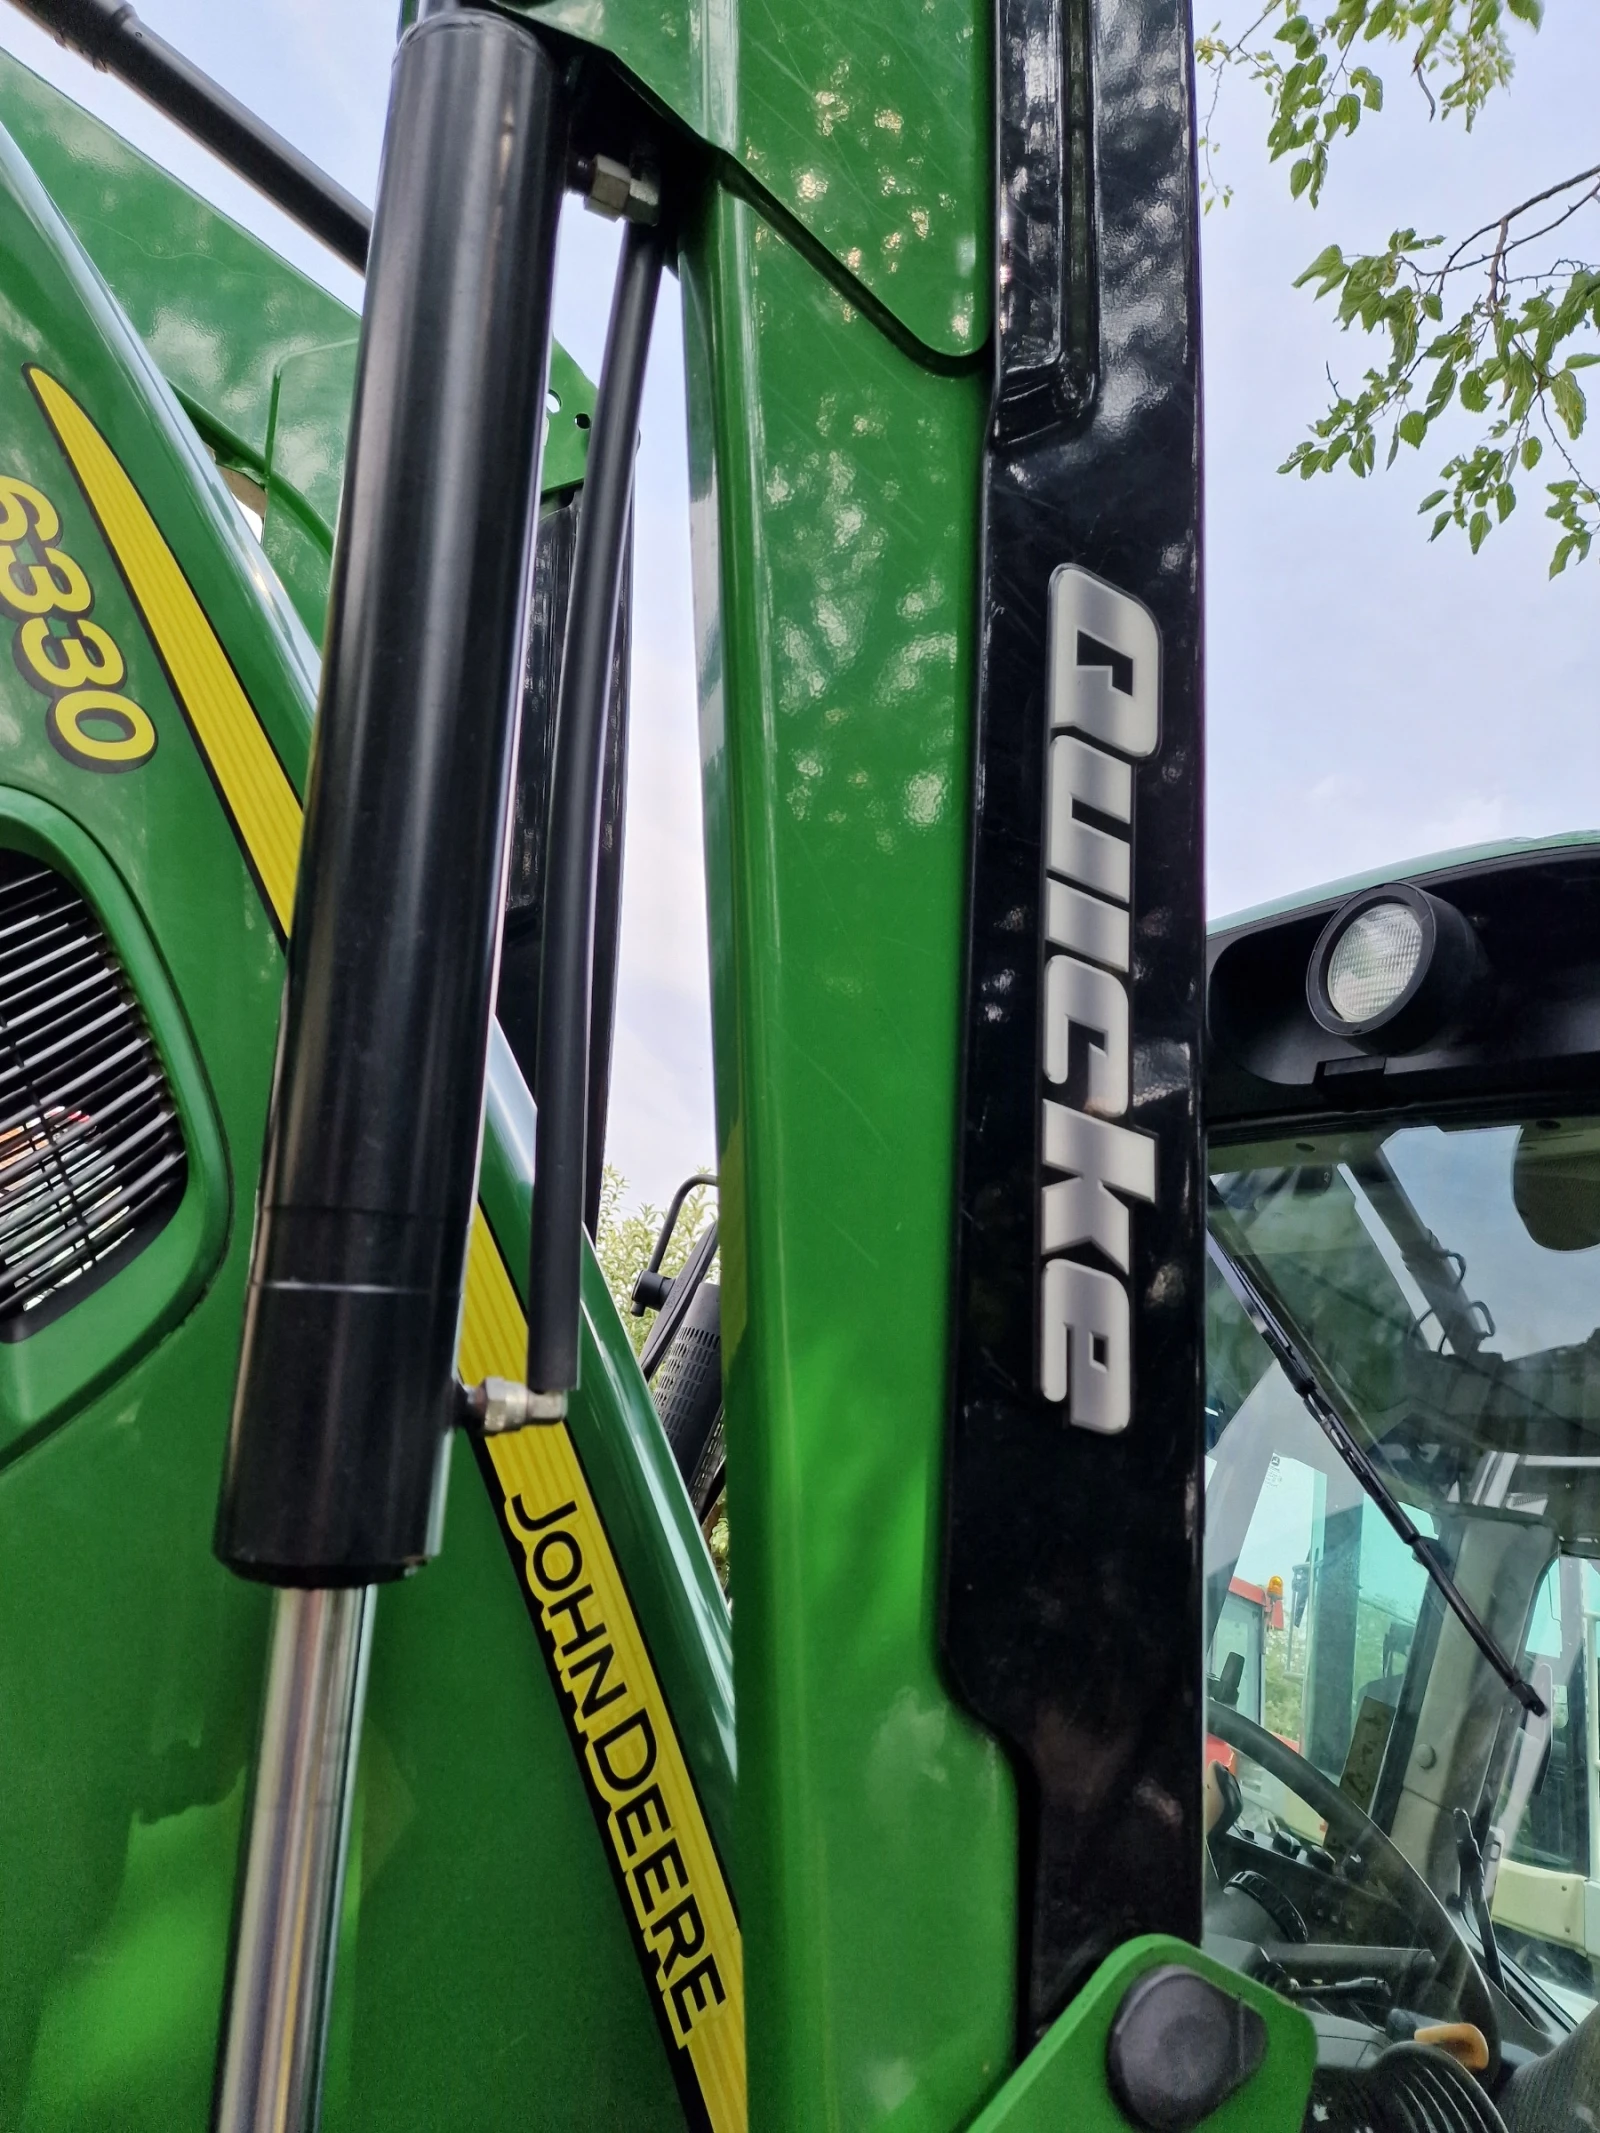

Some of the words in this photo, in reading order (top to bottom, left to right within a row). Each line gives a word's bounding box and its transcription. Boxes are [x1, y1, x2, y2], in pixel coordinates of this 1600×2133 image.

[0, 475, 156, 765] 6330
[1043, 562, 1161, 1434] Quicke
[509, 1493, 628, 1719] JOHN
[594, 1706, 727, 2036] DEERE
